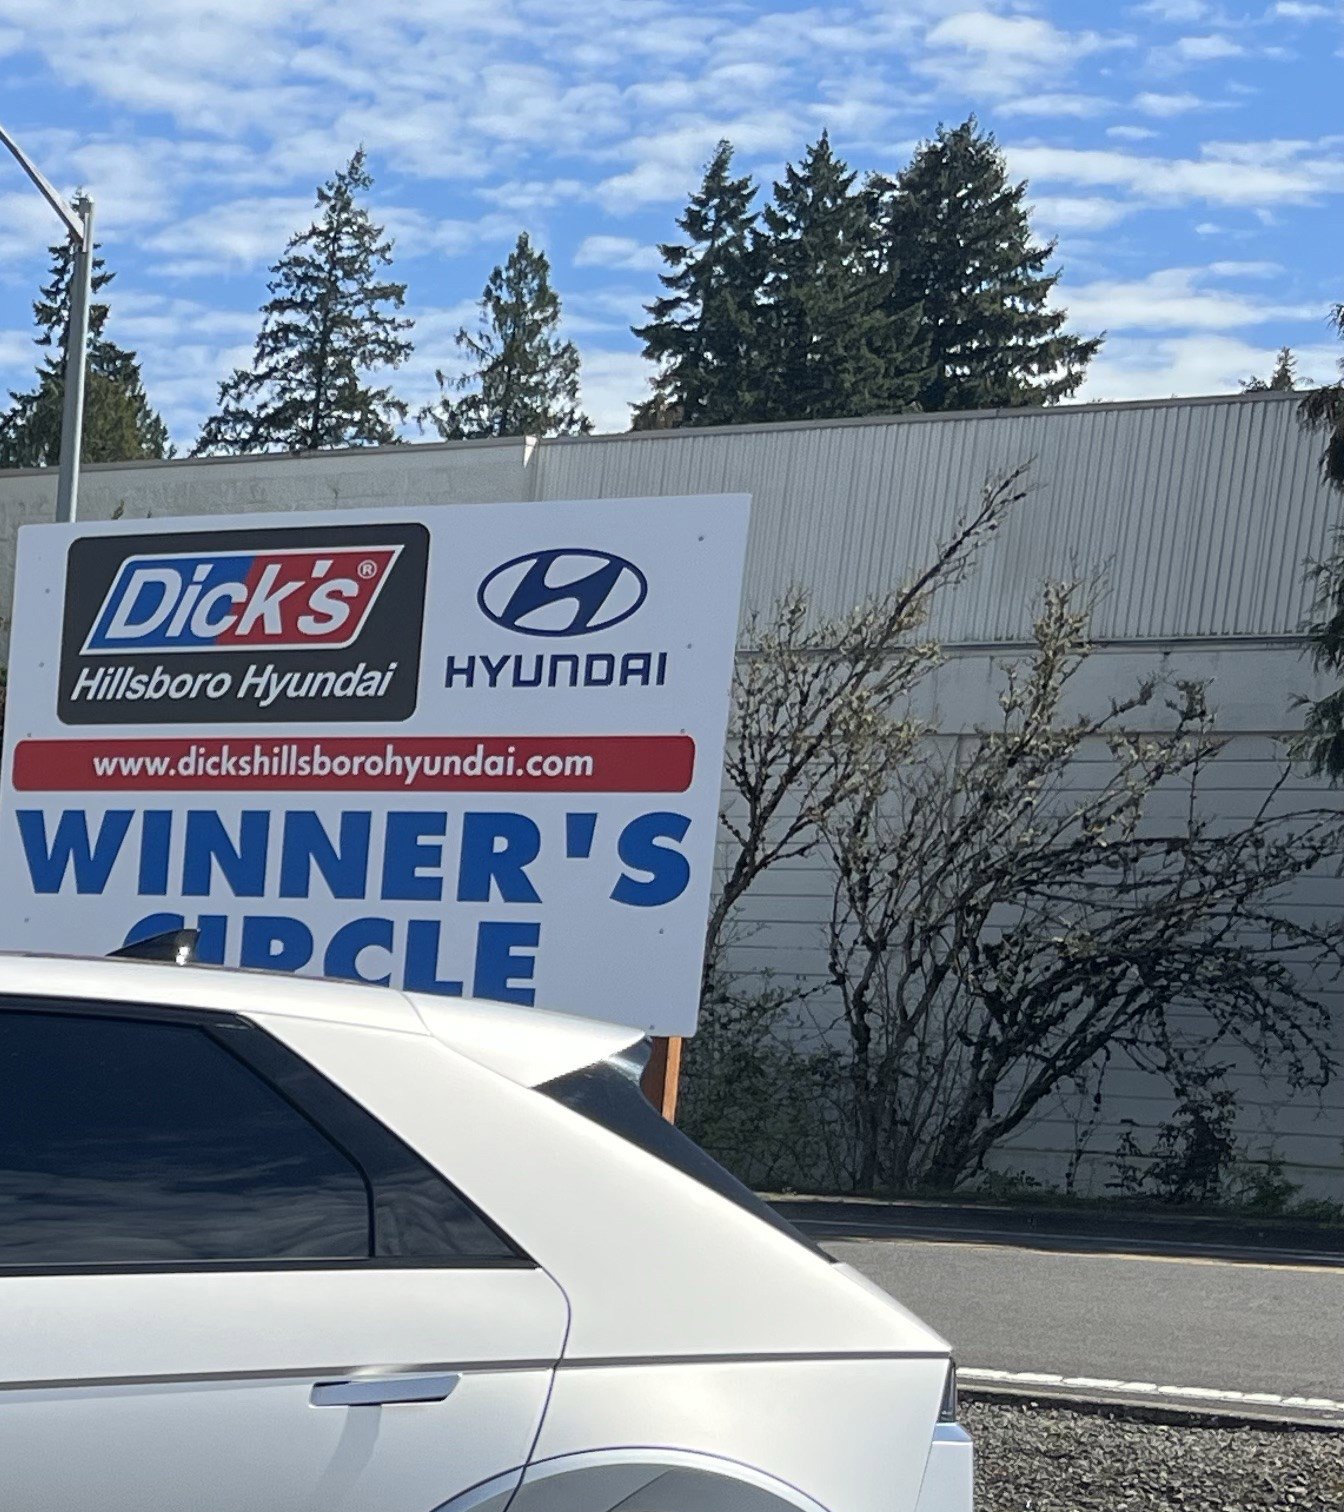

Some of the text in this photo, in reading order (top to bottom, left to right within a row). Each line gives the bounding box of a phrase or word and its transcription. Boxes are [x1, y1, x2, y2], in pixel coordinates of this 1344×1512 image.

[104, 559, 359, 640] Dick's
[70, 661, 399, 707] Hillsboro Hyundai
[445, 652, 668, 689] HYUNDAI
[92, 744, 594, 785] www.dickshillsborohyundai.com
[15, 809, 693, 908] WINNER'S
[123, 912, 542, 1008] IRCLE
